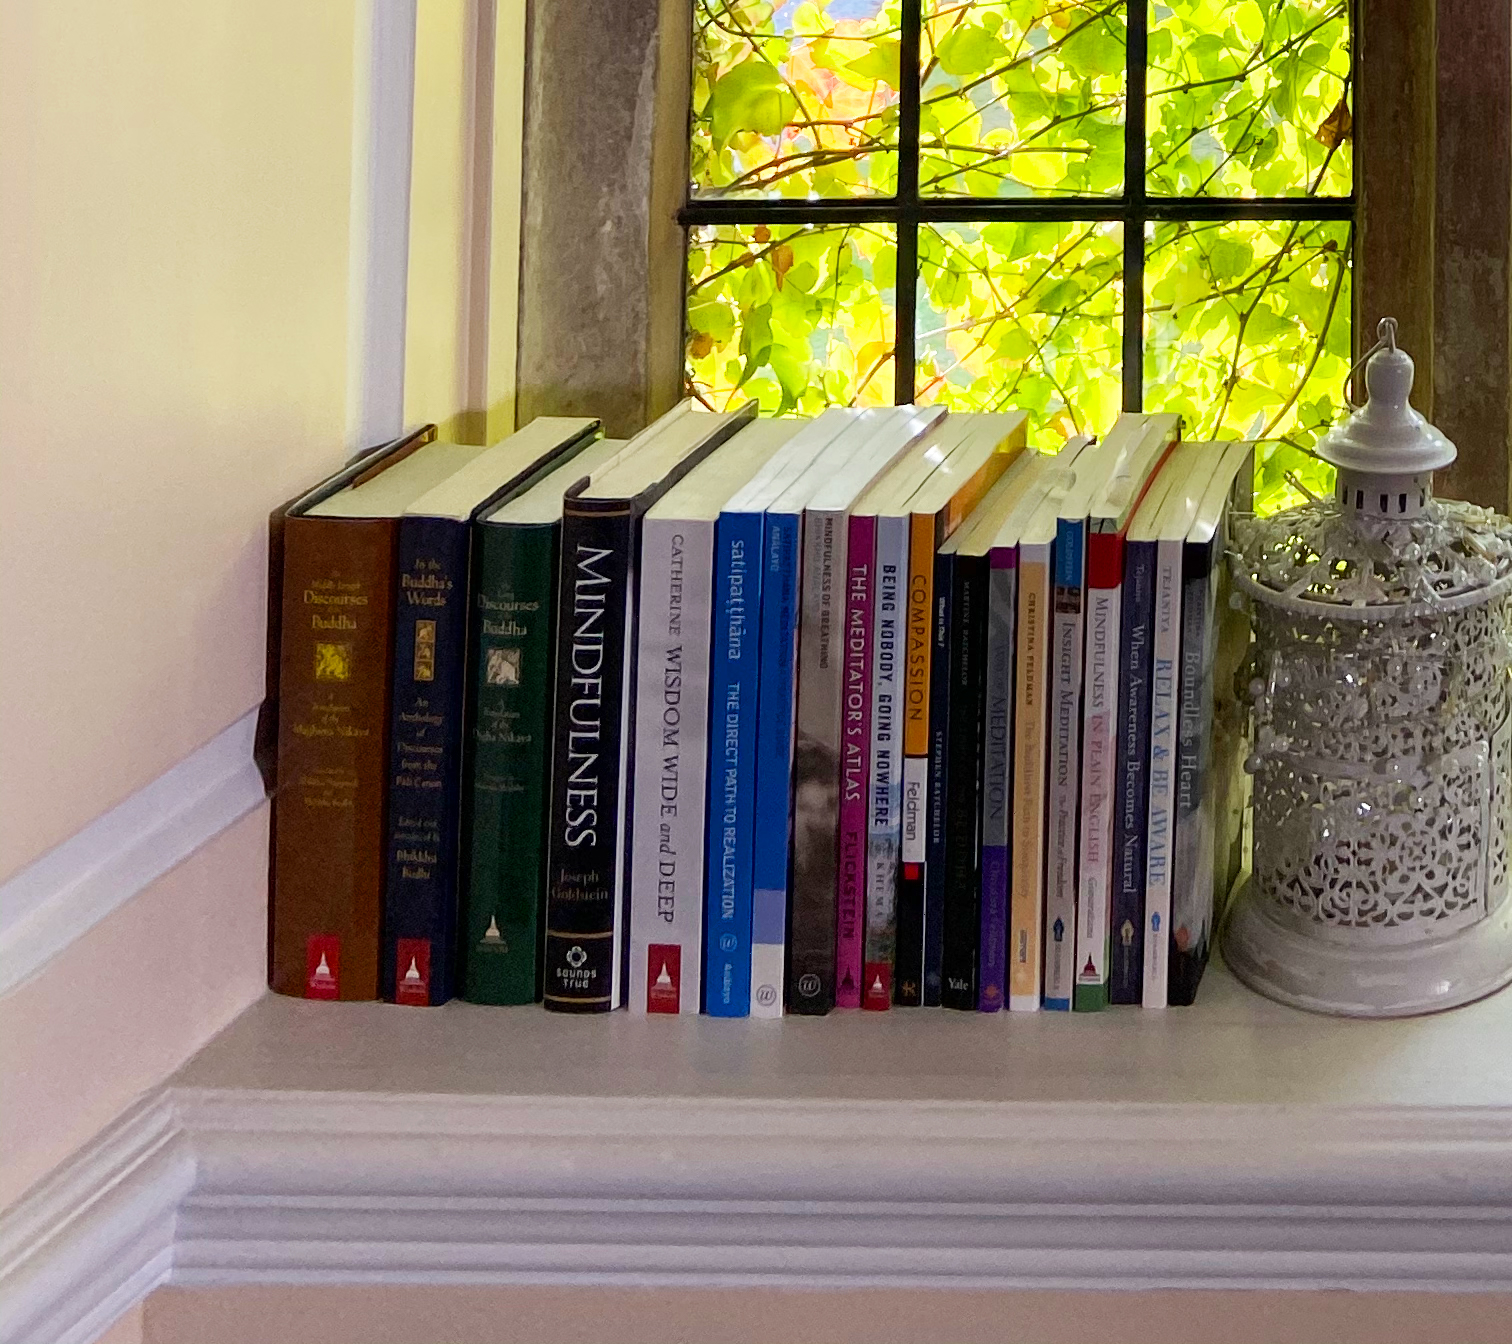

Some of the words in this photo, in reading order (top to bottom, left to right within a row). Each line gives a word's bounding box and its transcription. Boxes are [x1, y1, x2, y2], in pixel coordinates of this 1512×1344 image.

[401, 573, 453, 591] Buddha's
[822, 517, 833, 591] MINDFULNESS
[851, 563, 868, 601] THE
[303, 589, 369, 606] Discourses
[406, 591, 448, 607] Words
[477, 593, 541, 611] Discourses
[669, 534, 684, 637] CATHERINE
[724, 539, 747, 660] satipaṭṭhāna
[821, 593, 832, 605] OF
[881, 564, 896, 611] BEING
[962, 581, 970, 624] MARTINE
[1160, 565, 1172, 633] TEJANIYA
[311, 614, 358, 630] Buddha
[482, 619, 528, 636] Buddha
[819, 609, 831, 669] BREATHING
[909, 574, 927, 721] COMPASSION
[1026, 592, 1036, 651] CHRISTINA
[1130, 624, 1146, 670] When
[847, 609, 866, 735] MEDITATOR'S
[878, 619, 895, 686] NOBODY,
[961, 629, 969, 686] BATCHELOR
[1025, 655, 1035, 706] FELDMAN
[1061, 622, 1076, 685] INSIGHT
[1092, 596, 1110, 708] MINDFULNESS
[564, 544, 614, 847] MINDFULNESS
[663, 645, 682, 747] WISDOM
[727, 680, 741, 711] THE
[876, 693, 892, 742] GOING
[1091, 714, 1103, 733] IN
[1127, 673, 1143, 756] Awareness
[1154, 658, 1173, 739] RELAX
[1181, 651, 1201, 747] Boundless
[725, 713, 740, 766] DIRECT
[934, 730, 943, 778] STEPHEN
[988, 695, 1008, 820] MEDITATION
[1058, 689, 1075, 786] MEDITATION
[1090, 740, 1102, 787] PLAIN
[1153, 745, 1170, 760] &
[660, 755, 679, 817] WIDE
[724, 768, 737, 804] PATH
[844, 743, 862, 801] ATLAS
[874, 749, 891, 826] NOWHERE
[1125, 760, 1141, 830] Becomes
[1152, 769, 1169, 798] BE
[1179, 754, 1197, 809] Heart
[659, 823, 676, 855] and
[723, 808, 736, 824] TO
[905, 781, 920, 841] Feldman
[933, 781, 941, 844] BATCHELOR
[1087, 793, 1101, 863] ENGLISH
[560, 868, 600, 886] Joseph
[721, 827, 736, 919] REALIZATION
[1122, 833, 1139, 894] Natural
[1148, 807, 1168, 889] AWARE
[658, 860, 675, 923] DEEP
[842, 831, 858, 940] FLICKSTEIN
[947, 976, 969, 991] Yale
